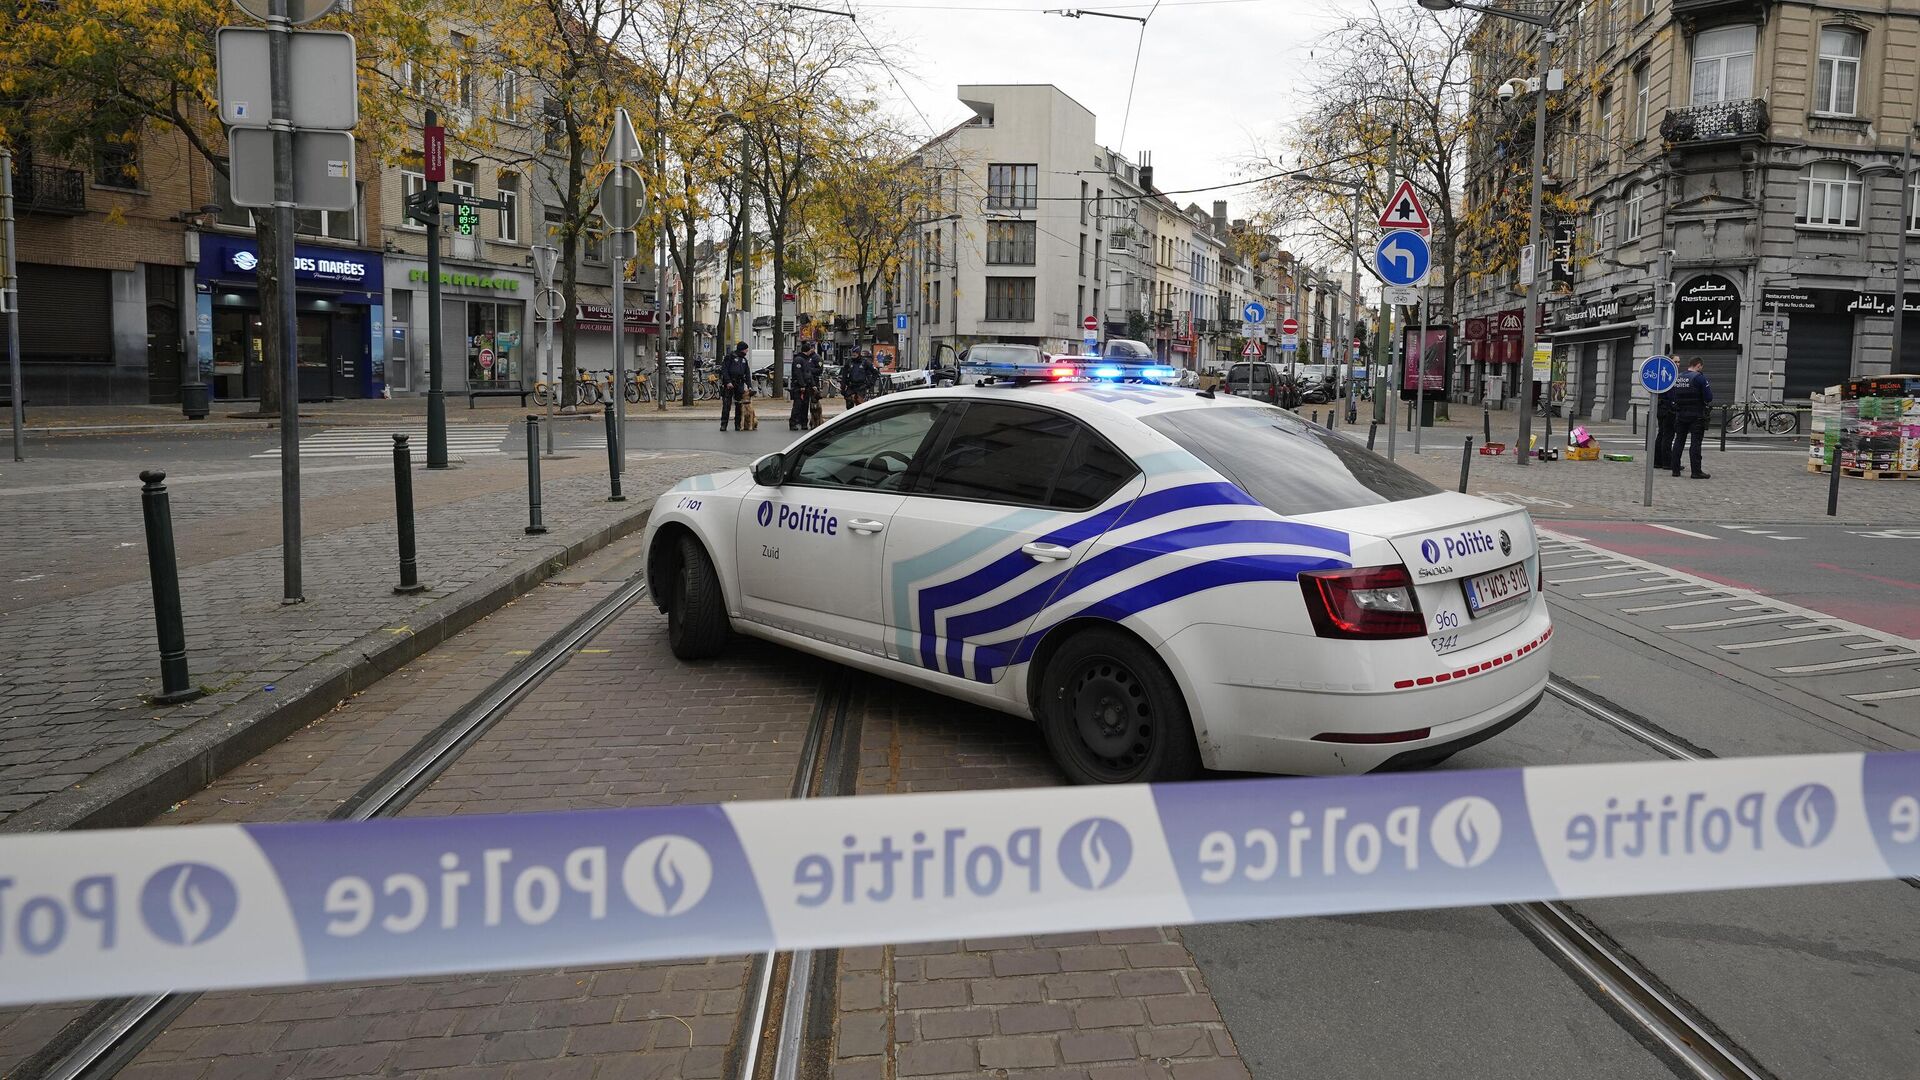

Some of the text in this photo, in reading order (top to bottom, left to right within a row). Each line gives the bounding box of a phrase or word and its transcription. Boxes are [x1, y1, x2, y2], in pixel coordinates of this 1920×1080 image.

[318, 260, 365, 275] MARÉES
[1690, 281, 1726, 294] مطعم
[588, 306, 614, 314] BOUCHE
[1589, 307, 1596, 318] YA
[1598, 303, 1618, 317] CHAM
[1679, 332, 1734, 341] YA CHAM
[686, 499, 702, 511] 101
[778, 504, 838, 536] Politie
[1444, 530, 1494, 558] Politie
[762, 545, 780, 559] Zuid
[1471, 597, 1478, 608] B
[1436, 611, 1458, 630] 960
